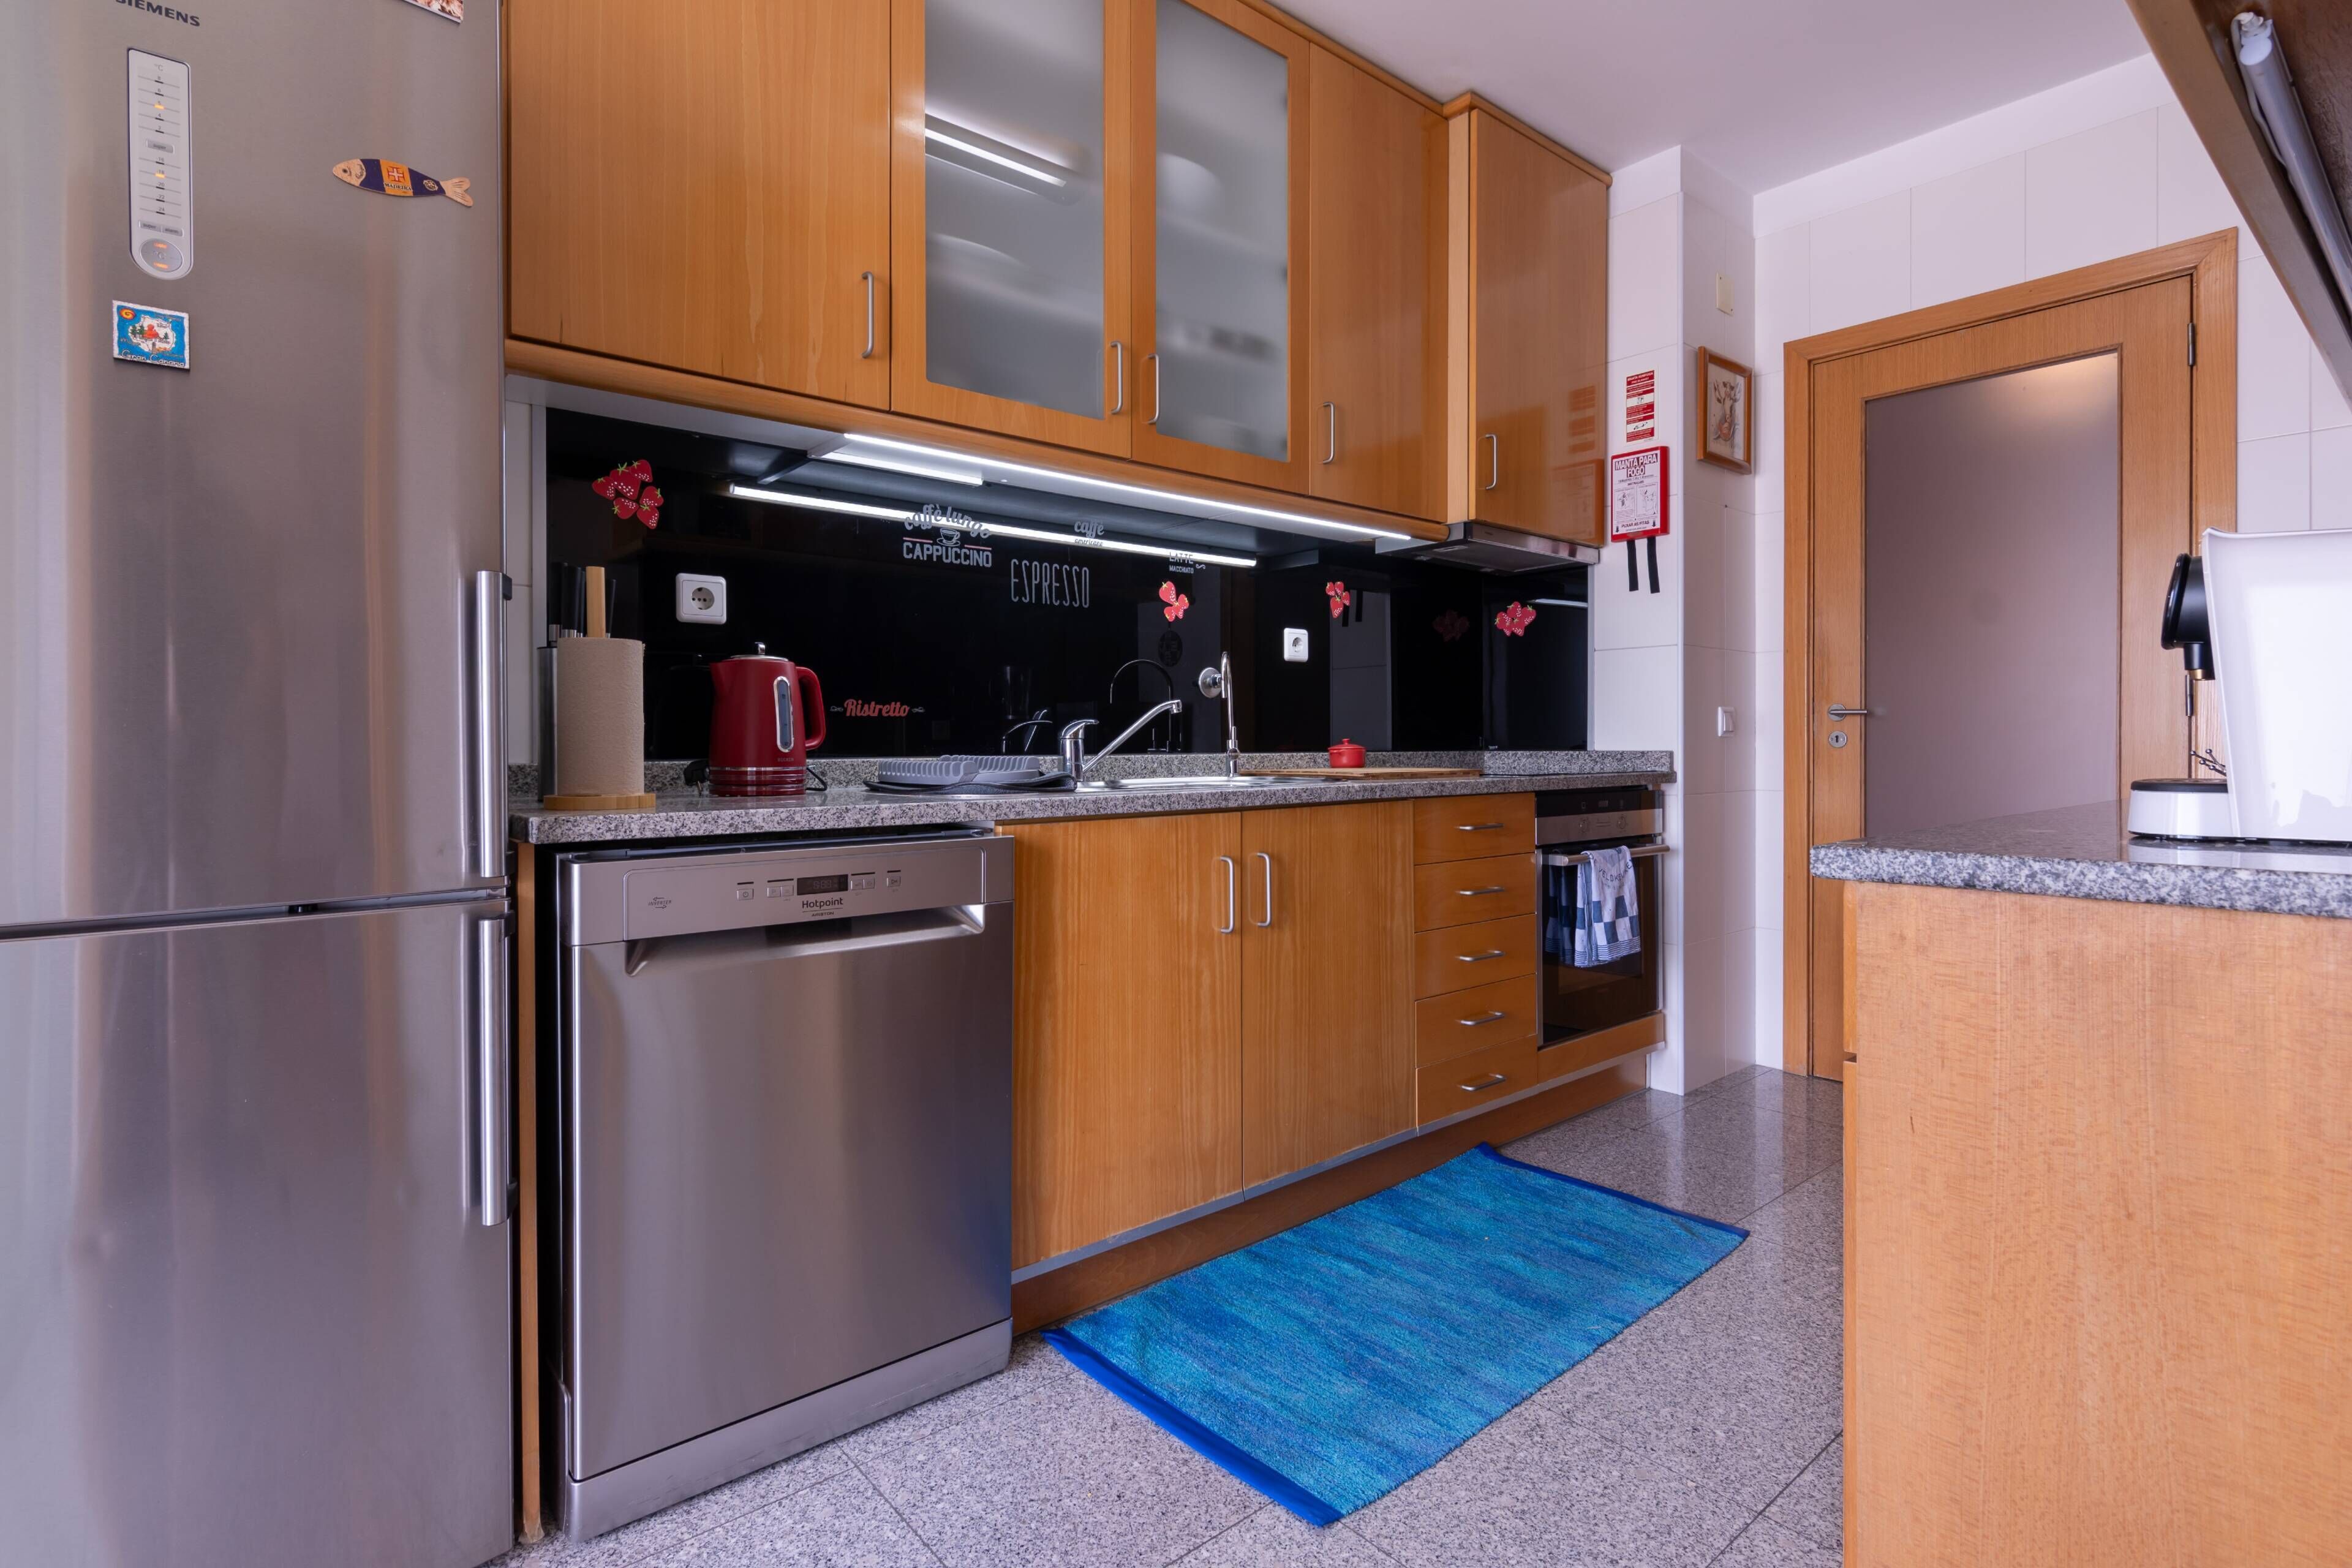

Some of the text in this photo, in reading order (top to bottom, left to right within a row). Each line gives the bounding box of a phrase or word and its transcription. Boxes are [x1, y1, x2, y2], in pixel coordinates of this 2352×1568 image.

[384, 183, 412, 191] MADEIRA
[122, 349, 147, 362] Gran
[1615, 454, 1657, 470] MANTA PARA
[1627, 466, 1645, 477] FOGO
[946, 506, 990, 538] lungo
[903, 541, 992, 568] CAPPUCCINO
[1169, 551, 1194, 564] LATTE
[1169, 565, 1194, 574] MACCHIATO
[1011, 559, 1090, 608] ESPRESSO
[843, 698, 910, 717] Ristretto
[802, 897, 843, 909] Hotpoint
